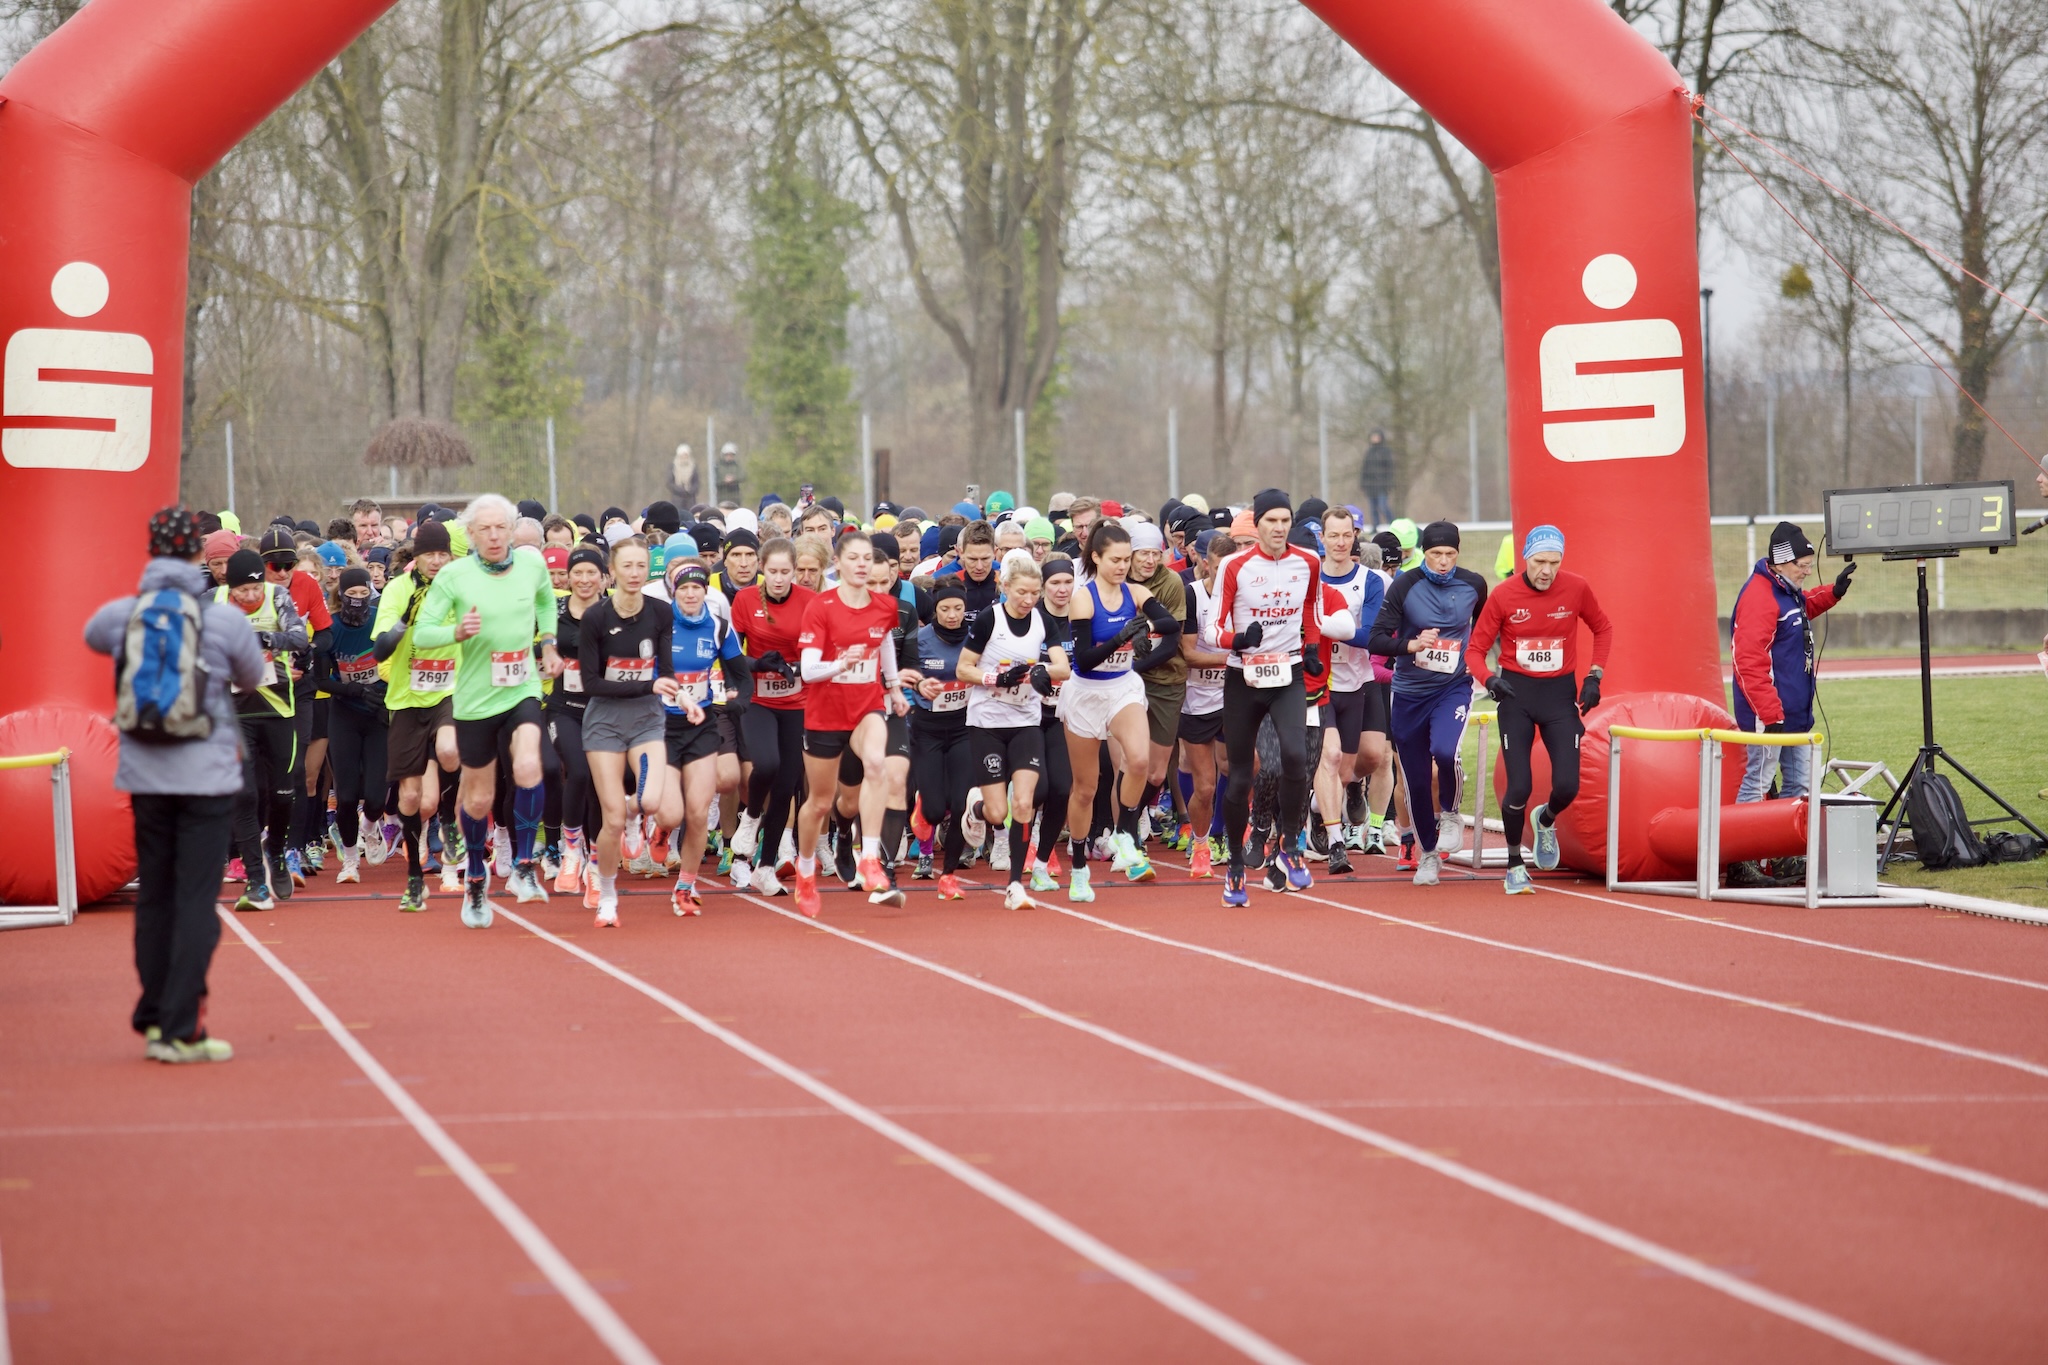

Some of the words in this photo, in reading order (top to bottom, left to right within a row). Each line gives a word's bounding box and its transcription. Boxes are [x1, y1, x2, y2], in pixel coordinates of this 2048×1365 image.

[1250, 607, 1300, 618] TriStar
[1426, 651, 1450, 663] 445
[1527, 651, 1552, 663] 468
[346, 668, 375, 682] 1929
[418, 671, 449, 683] 2697
[1198, 668, 1226, 680] 1973
[1255, 664, 1280, 678] 960
[944, 690, 966, 703] 958
